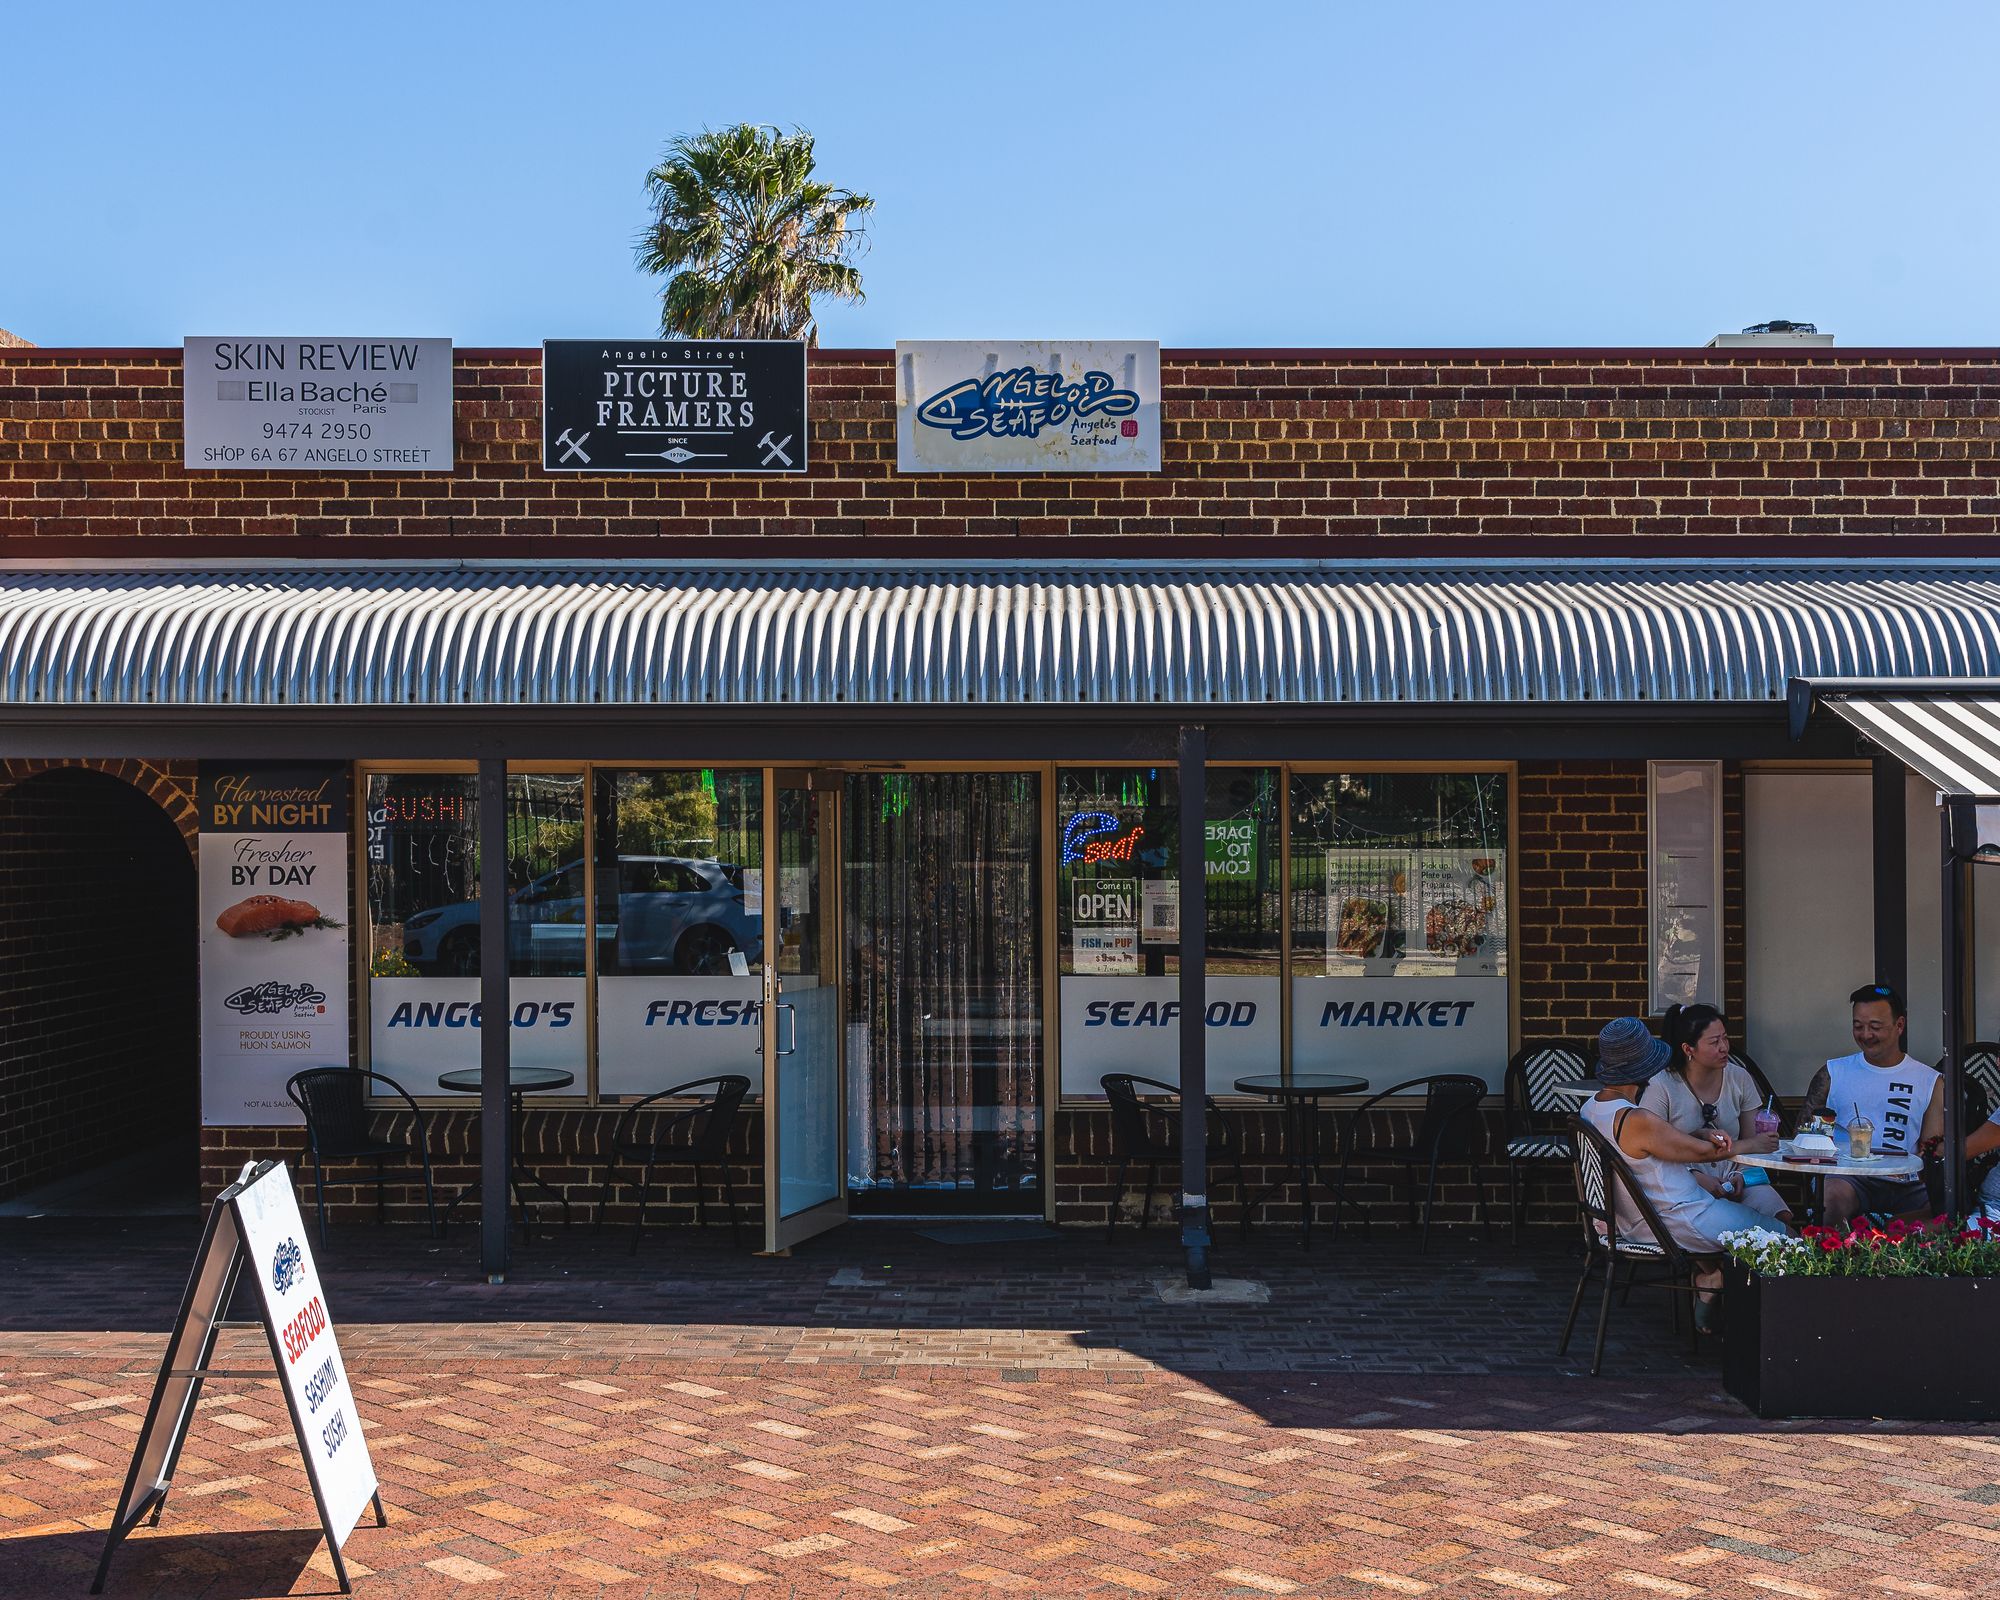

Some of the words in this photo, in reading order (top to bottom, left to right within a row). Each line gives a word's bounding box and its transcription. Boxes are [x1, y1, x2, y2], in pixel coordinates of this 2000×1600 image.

[214, 343, 285, 371] SKIN
[299, 344, 418, 371] REVIEW
[602, 350, 668, 360] Angelo
[684, 350, 745, 360] Street
[249, 381, 294, 402] Ella
[301, 381, 387, 402] Baché
[603, 371, 747, 398] PICTURE
[298, 407, 336, 416] STOCKIST
[353, 403, 386, 414] Paris
[596, 400, 754, 427] FRAMERS
[263, 422, 313, 439] 9474
[321, 423, 371, 440] 2950
[1070, 417, 1116, 433] Angelo's
[1070, 434, 1117, 446] Seafood
[204, 447, 244, 461] SHOP
[251, 448, 272, 461] 6A
[278, 448, 298, 461] 67
[304, 448, 367, 462] ANGELO
[373, 449, 431, 463] STREET
[214, 775, 330, 802] Harvested
[214, 804, 244, 825] BY
[251, 804, 332, 825] NIGHT
[384, 797, 464, 821] SUSHI
[233, 837, 312, 863] Fresher
[231, 865, 261, 886] BY
[269, 865, 317, 886] DAY
[1096, 881, 1120, 890] Come
[1122, 881, 1132, 890] in
[1078, 893, 1132, 918] OPEN
[1081, 938, 1101, 948] FISH
[1114, 938, 1133, 948] PUP
[1084, 1000, 1257, 1027] SEAFOD
[1320, 1001, 1475, 1027] MARKET
[239, 1030, 279, 1039] PROUDLY
[281, 1030, 311, 1039] USING
[239, 1041, 268, 1050] HUON
[271, 1041, 311, 1050] SALMON
[282, 1296, 326, 1365] SEAFOOD
[304, 1355, 338, 1414] SASHIMI
[322, 1408, 348, 1459] SUSHI
